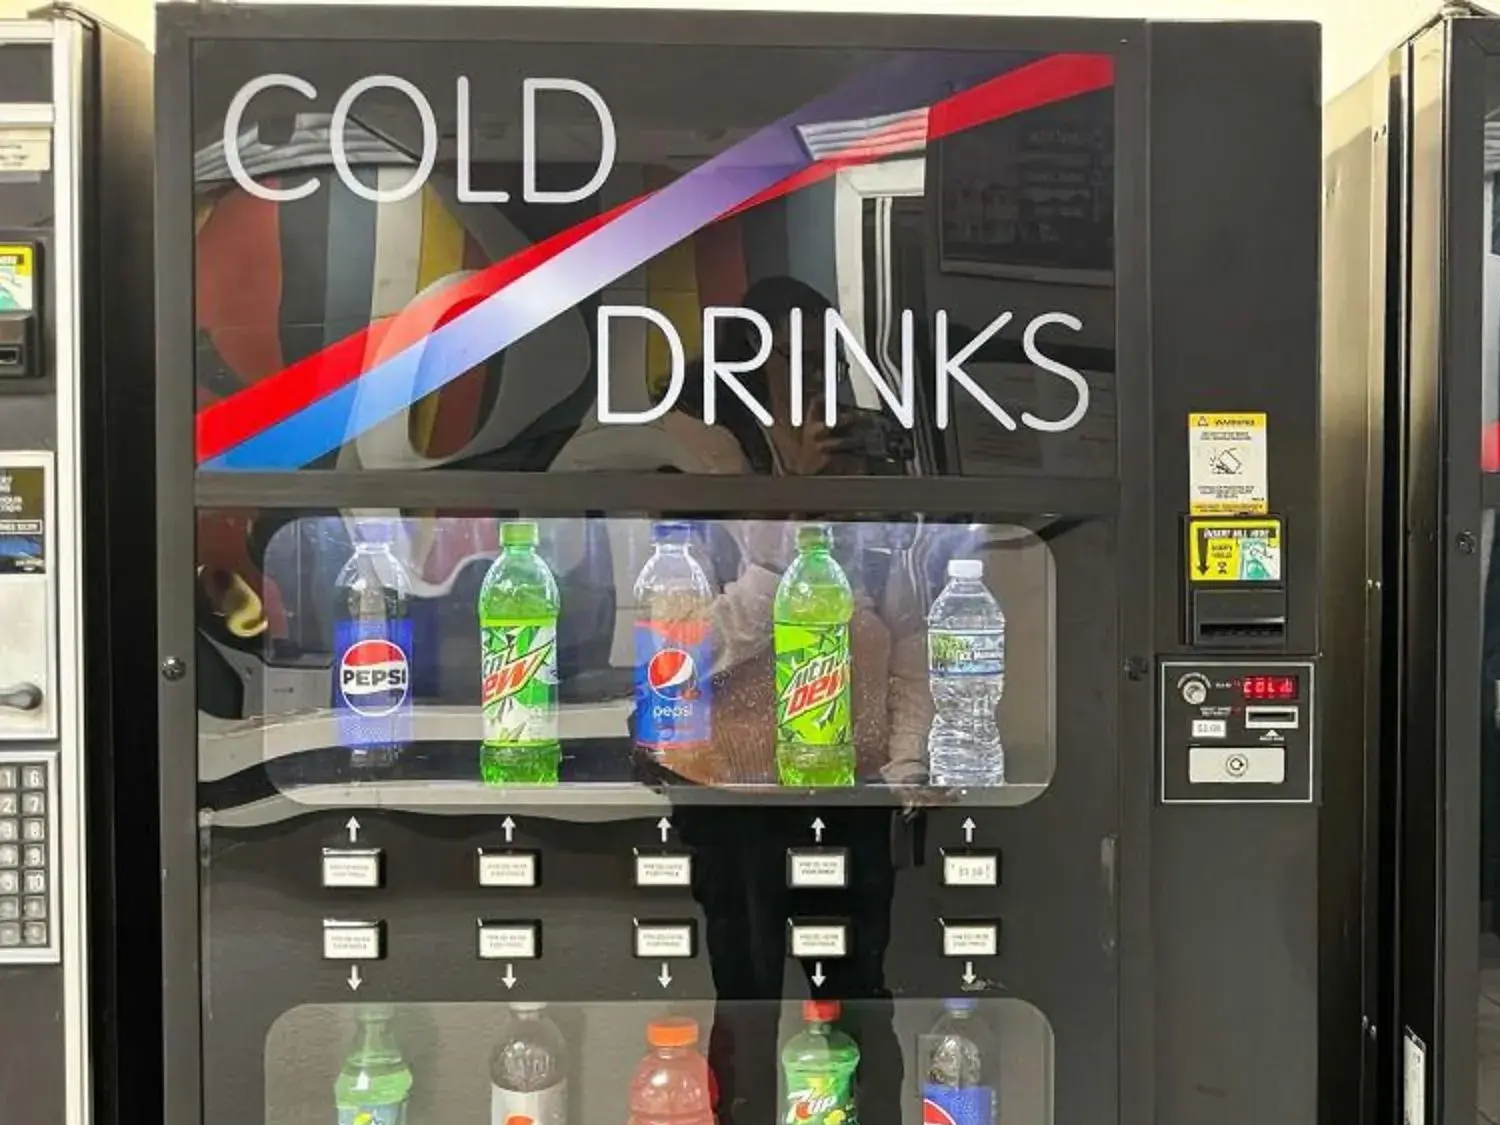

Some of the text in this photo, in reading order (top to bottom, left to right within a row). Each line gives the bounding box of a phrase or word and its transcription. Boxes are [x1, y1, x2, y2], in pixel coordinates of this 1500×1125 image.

[212, 74, 616, 204] COLD
[598, 306, 1089, 432] DRINKS
[343, 668, 406, 686] PEPSI
[653, 704, 694, 719] pepsi
